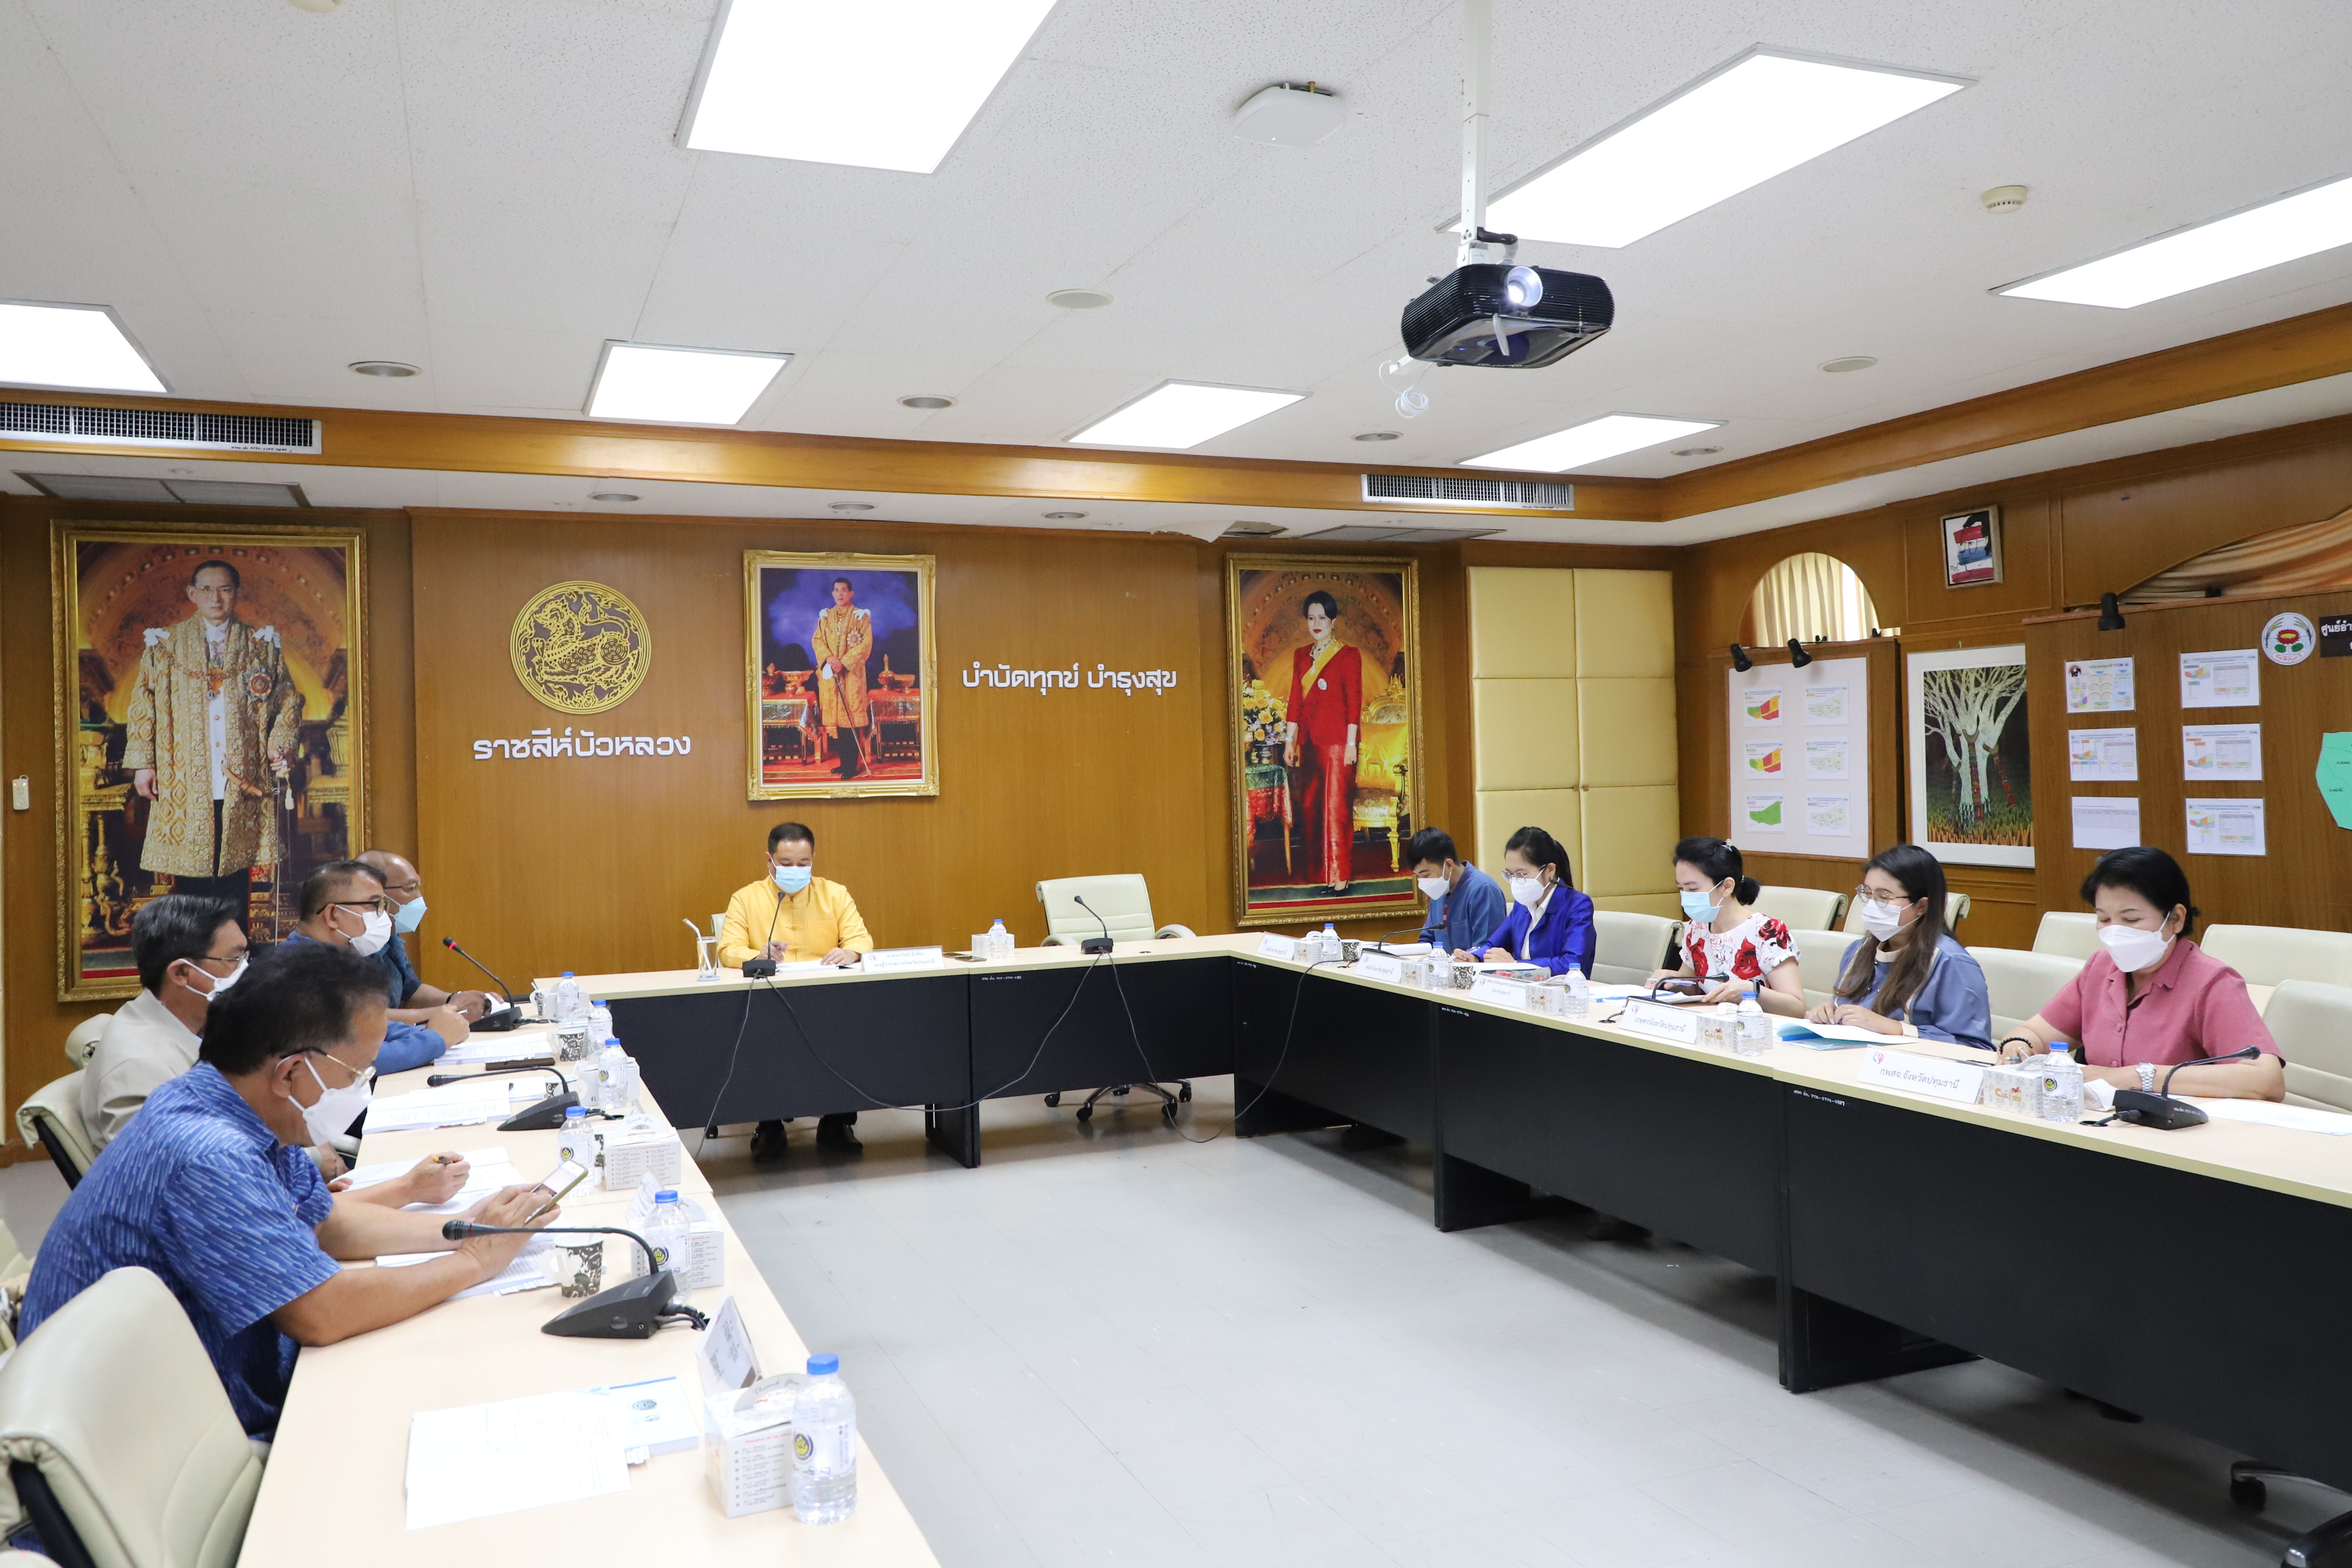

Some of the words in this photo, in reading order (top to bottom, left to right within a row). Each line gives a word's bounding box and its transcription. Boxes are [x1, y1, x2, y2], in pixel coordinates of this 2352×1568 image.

[962, 661, 1080, 696] บำบัดทุกข์
[1088, 663, 1177, 696] บำรุงสุข
[473, 726, 691, 760] ราชสีห์บัวหลวง
[1634, 1016, 1687, 1032] เกษตรจังหวัดปทุมธานี
[1880, 1068, 1960, 1089] กพสจ.จังหวัดปทุมธานี
[626, 1117, 641, 1125] Thank
